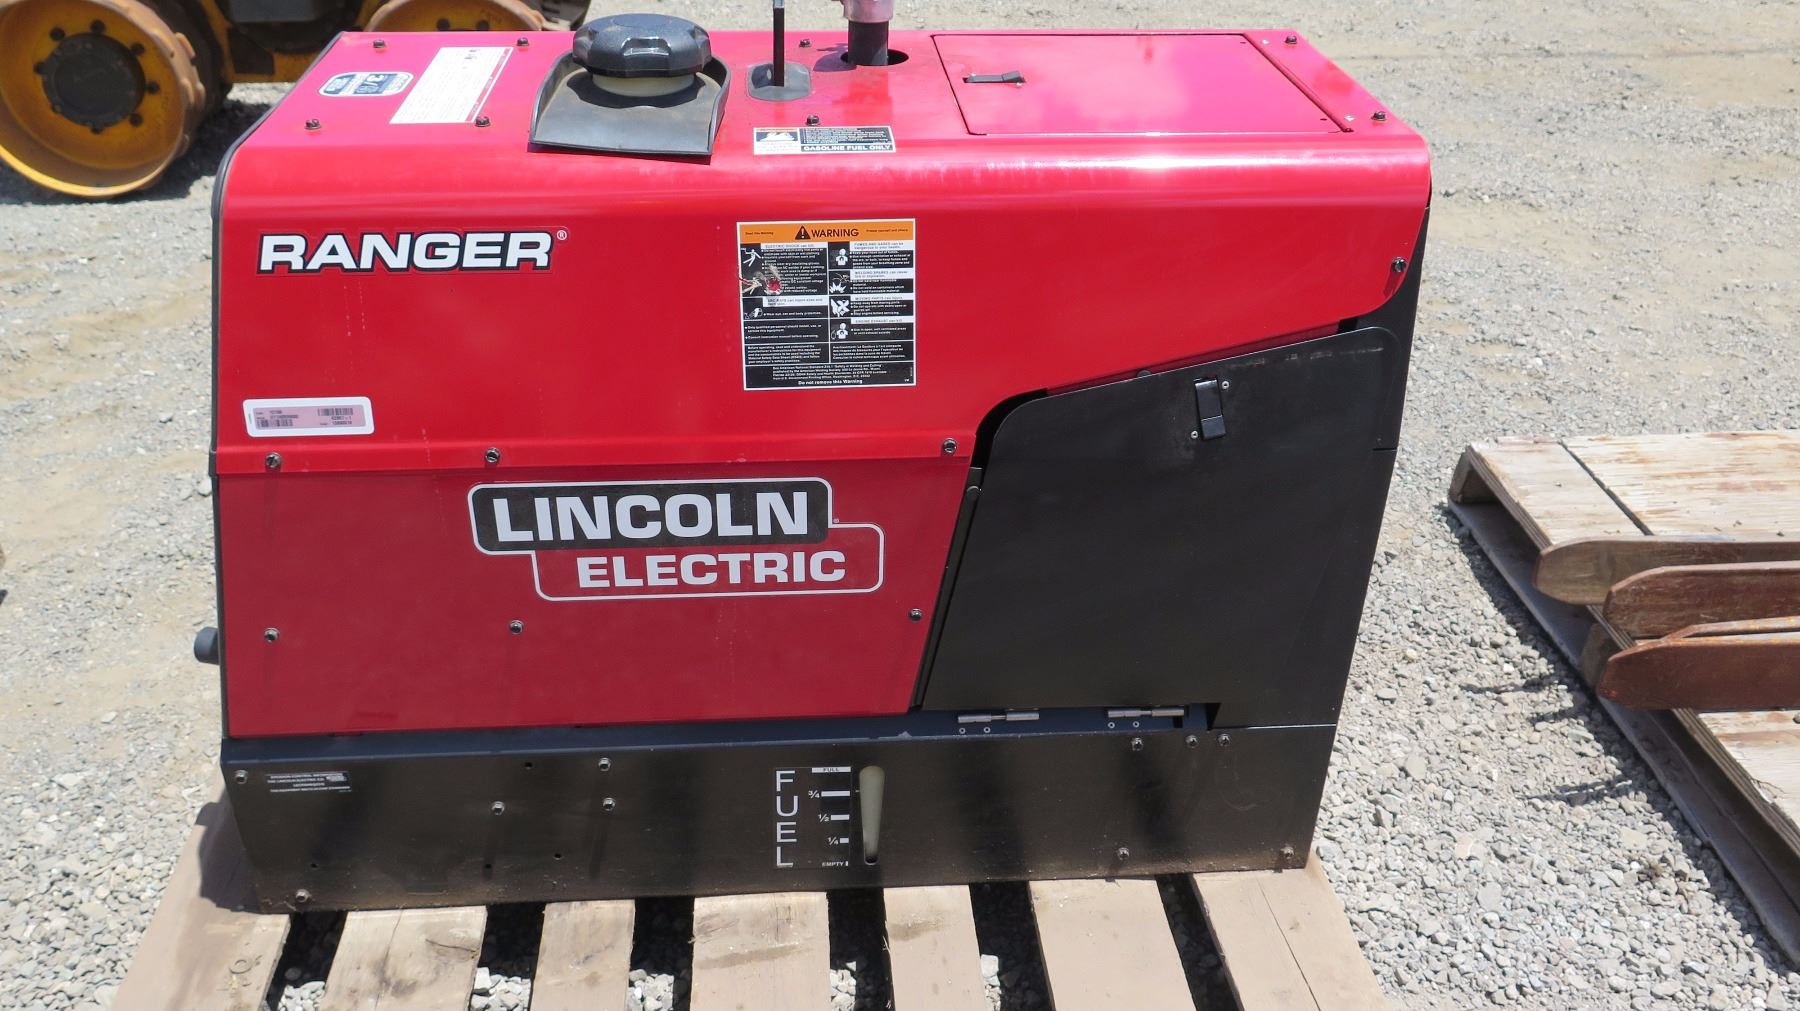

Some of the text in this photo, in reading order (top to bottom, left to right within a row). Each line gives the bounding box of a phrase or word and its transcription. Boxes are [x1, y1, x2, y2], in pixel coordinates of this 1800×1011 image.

[258, 231, 551, 272] RANGER
[811, 228, 860, 239] WARNING
[492, 491, 808, 542] LINCOLN
[576, 550, 846, 589] ELECTRIC
[776, 770, 799, 868] FUEL
[818, 813, 829, 823] 1/2
